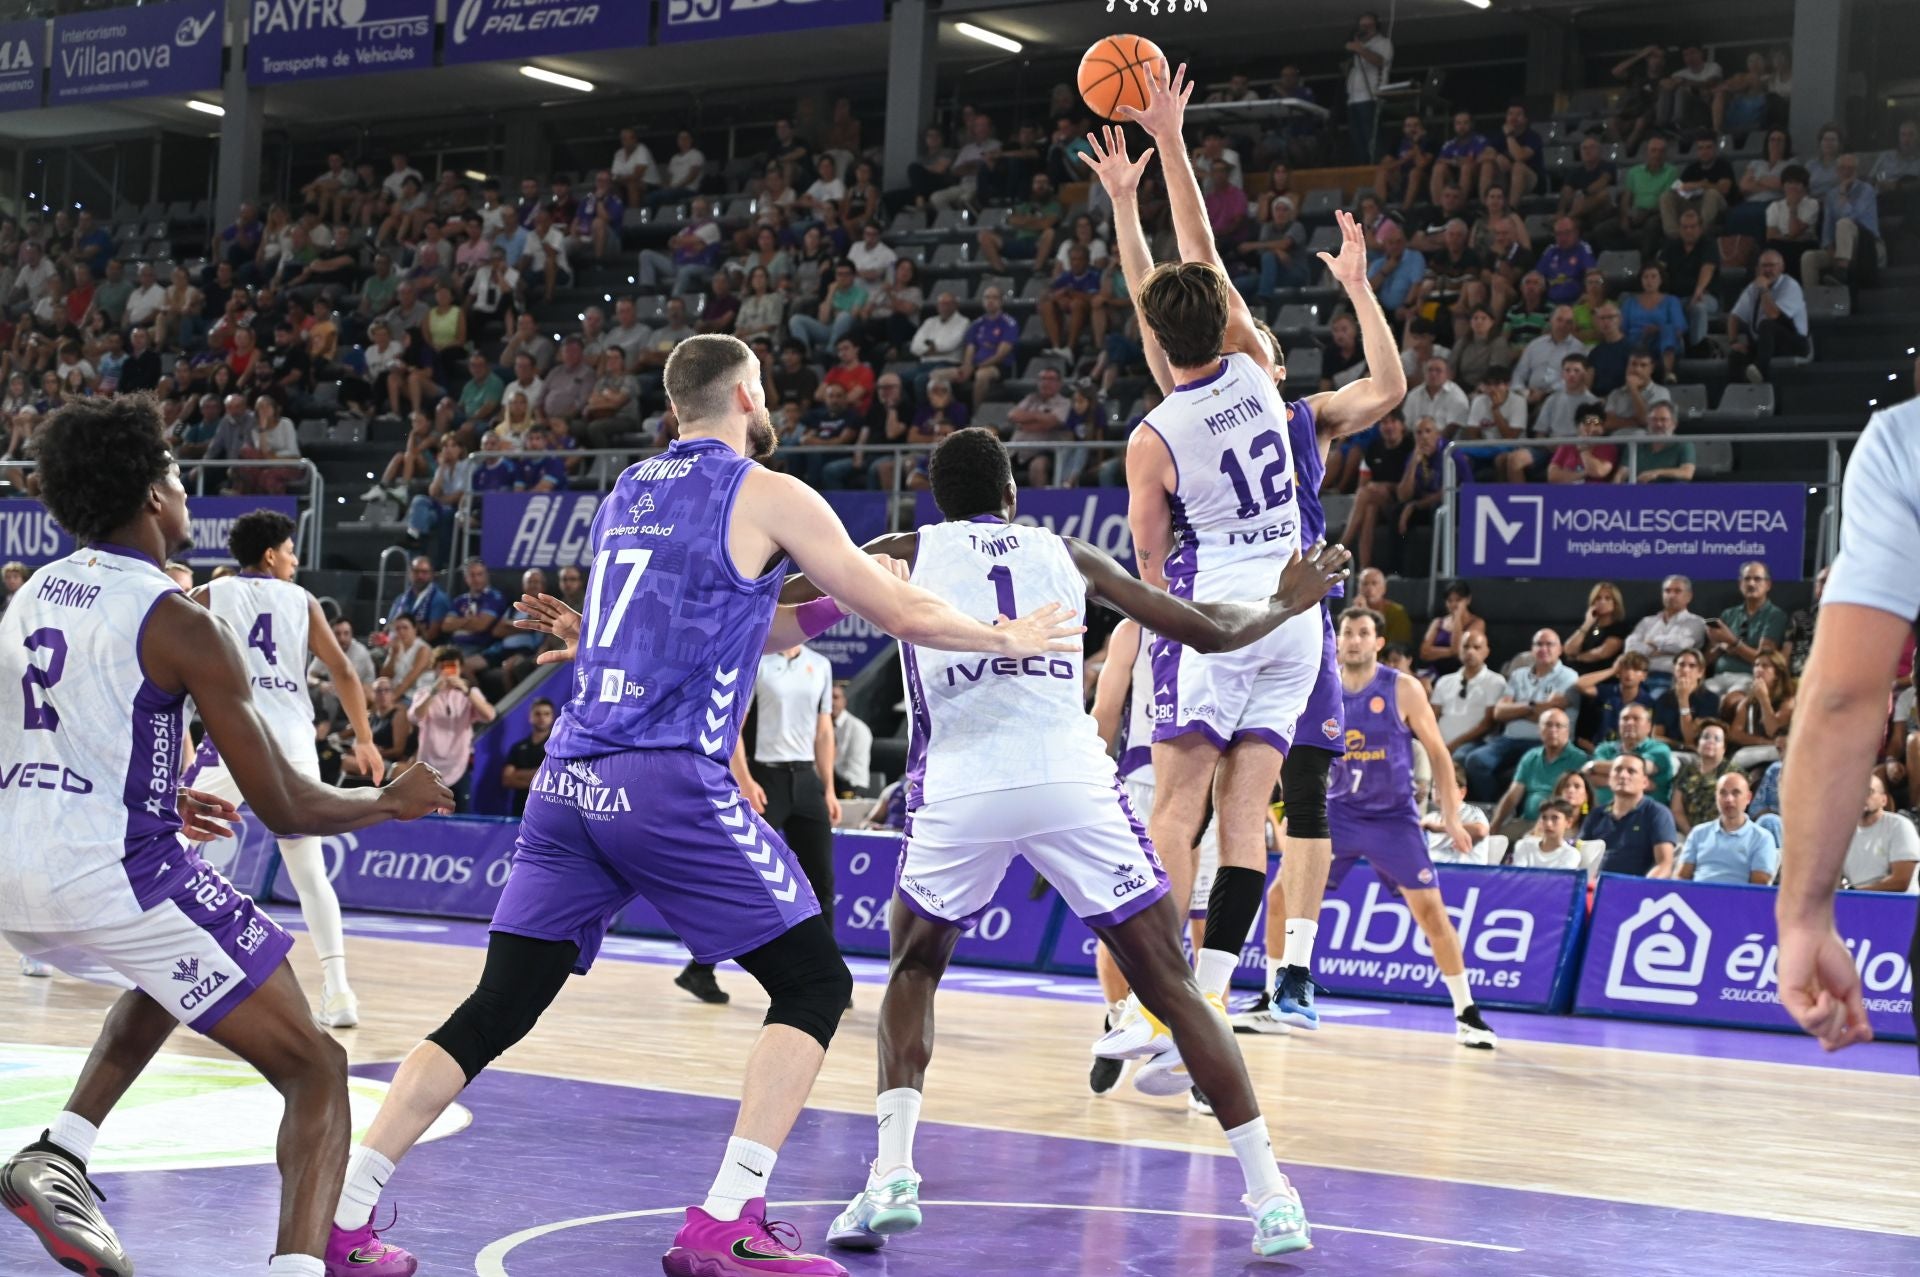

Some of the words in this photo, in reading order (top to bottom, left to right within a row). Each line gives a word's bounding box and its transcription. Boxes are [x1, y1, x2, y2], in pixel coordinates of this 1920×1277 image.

[62, 25, 127, 44] Interiorismo
[481, 5, 600, 35] PALENCIA
[61, 45, 171, 78] Villanova
[262, 55, 328, 74] Transporte
[333, 49, 350, 67] de
[1204, 395, 1263, 436] MARTÍN
[1219, 429, 1293, 520] 12
[189, 517, 236, 550] CNIC
[640, 522, 675, 537] salud
[1552, 508, 1788, 533] MORALESCERVERA
[1567, 538, 1652, 558] Implantología
[1655, 539, 1699, 556] Dental
[1702, 539, 1766, 557] Inmediata
[37, 575, 101, 609] HANNA
[586, 549, 653, 648] 17
[987, 564, 1017, 625] 1
[248, 613, 277, 666] 4
[22, 627, 68, 732] 2
[946, 655, 1074, 687] IVECO
[625, 681, 645, 699] Dip
[149, 712, 170, 793] aspasia
[1351, 768, 1363, 794] 7
[544, 794, 564, 805] AGUA
[359, 849, 475, 884] ramos
[236, 917, 264, 951] CBC
[180, 970, 230, 1011] CRZA
